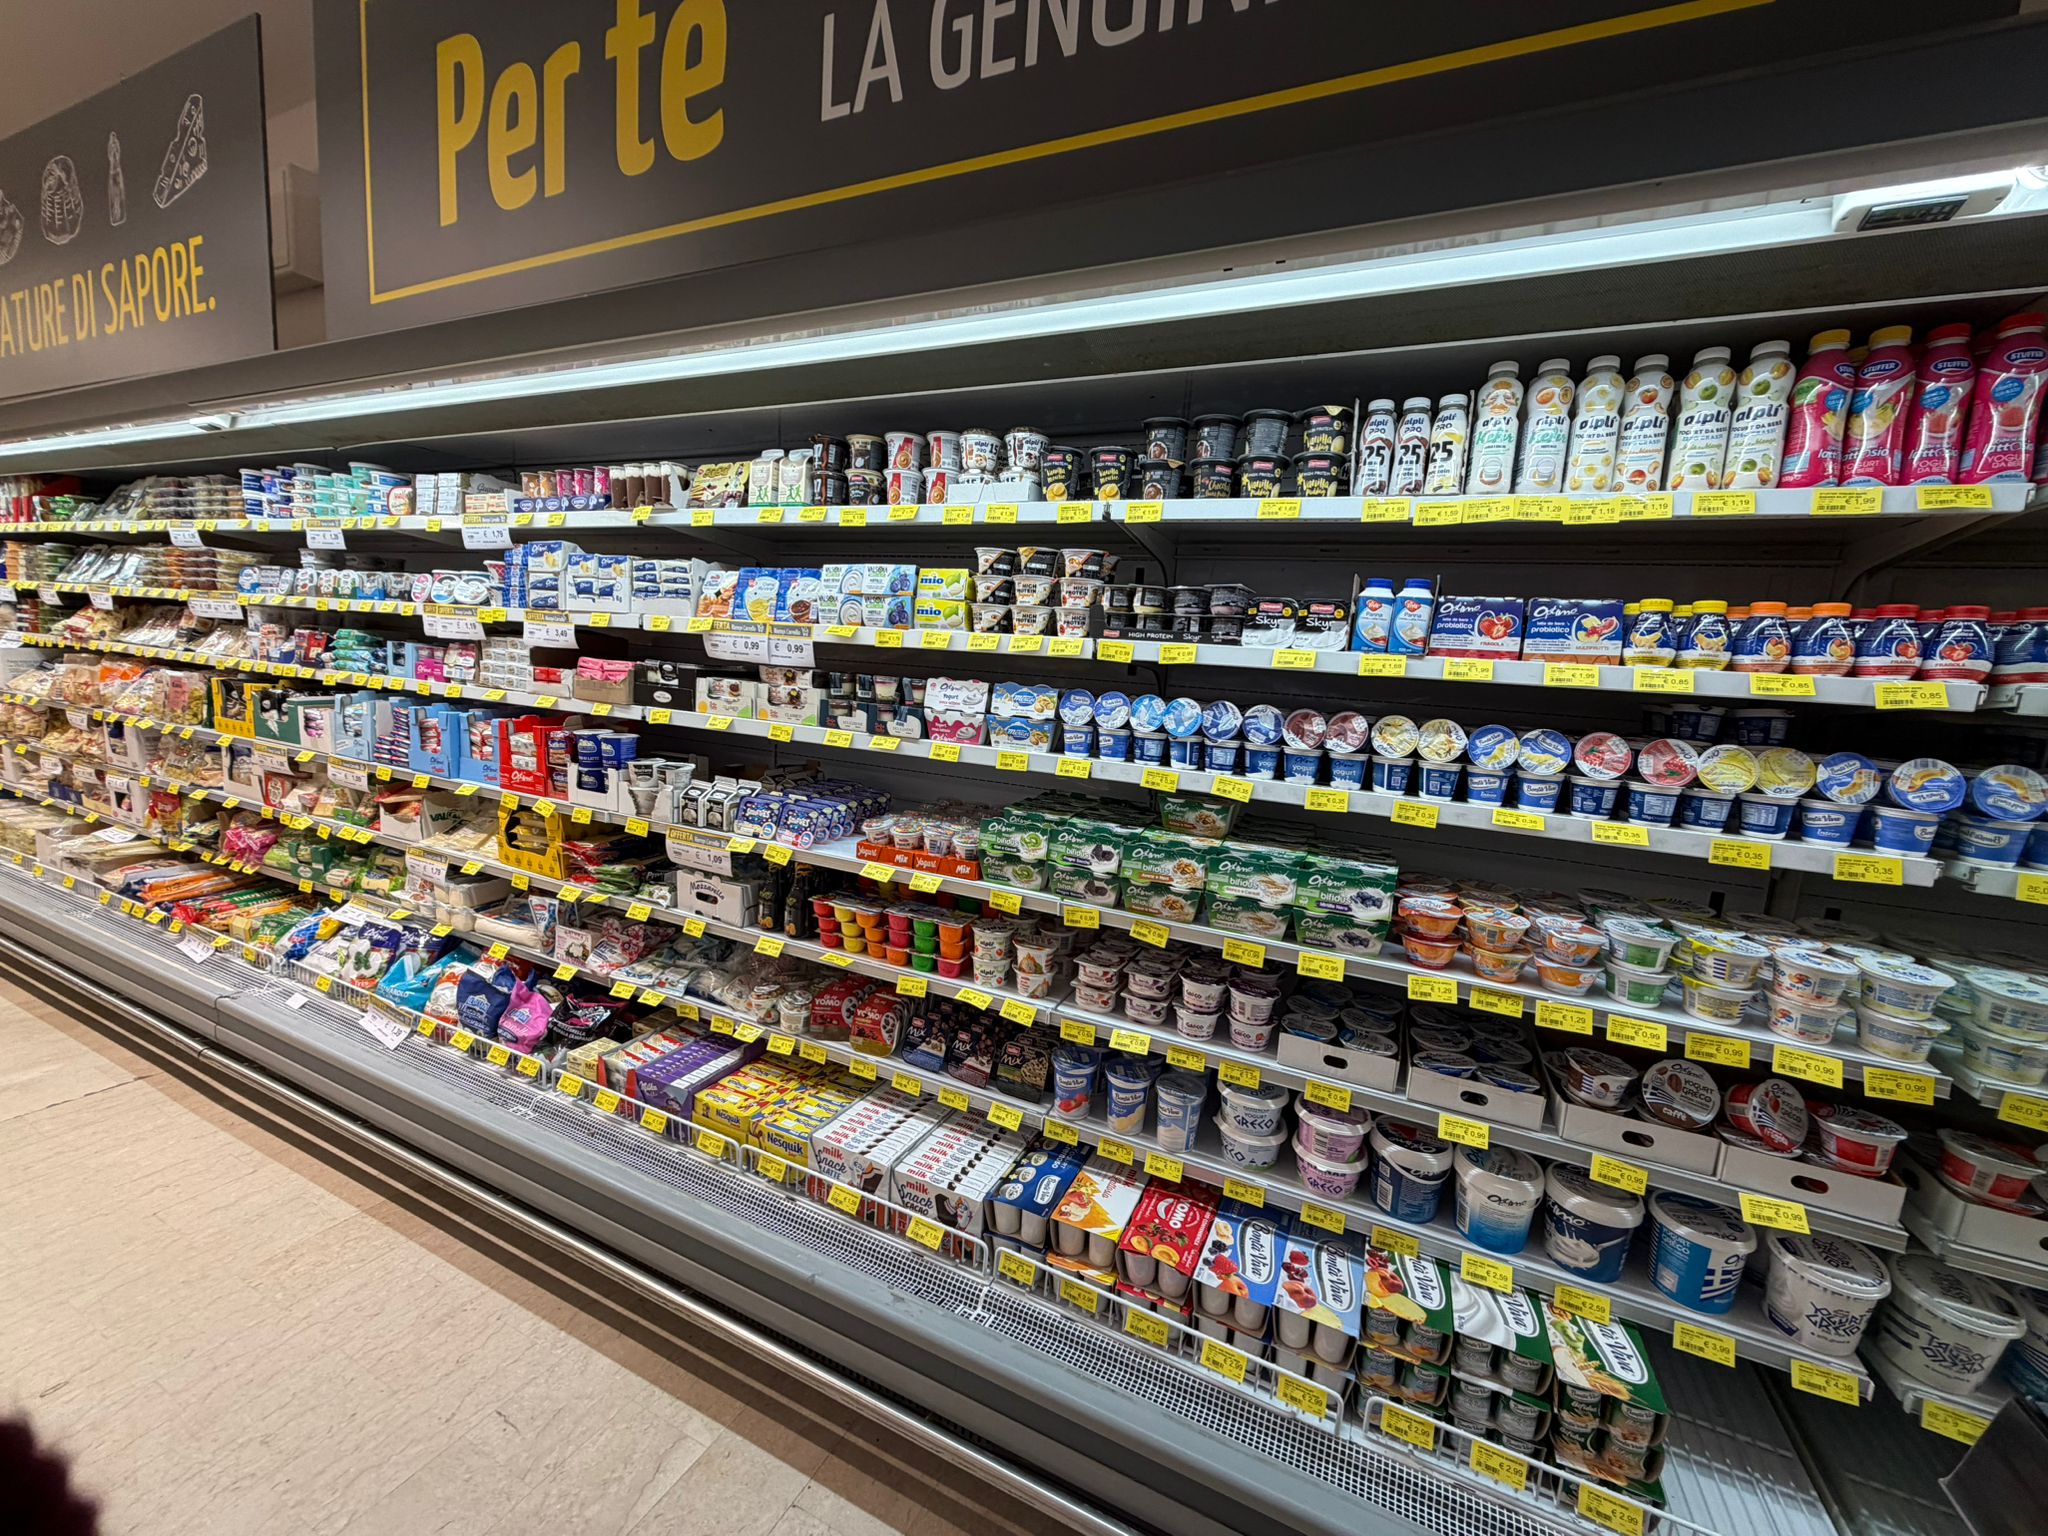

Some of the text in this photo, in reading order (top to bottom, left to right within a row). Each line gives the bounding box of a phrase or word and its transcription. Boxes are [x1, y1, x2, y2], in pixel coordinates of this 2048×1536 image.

[821, 0, 903, 122] LA
[435, 33, 581, 228] Per
[605, 0, 727, 177] te
[72, 270, 96, 340] DI
[101, 235, 216, 334] SAPORE.
[1863, 362, 1899, 373] STUFFER
[1364, 446, 1386, 465] 25
[1430, 441, 1454, 464] 25
[1854, 497, 1876, 505] 1,99
[920, 576, 944, 585] mio
[917, 607, 941, 616] mio
[1255, 616, 1282, 628] Skyr
[1306, 617, 1335, 630] Skyr
[1437, 622, 1473, 630] probiotico
[1182, 633, 1202, 642] Skyr
[744, 641, 760, 650] 0,99
[787, 644, 804, 654] 0,99
[1333, 769, 1356, 777] yogurt
[1422, 812, 1436, 820] 0,35
[707, 853, 722, 864] 1,09
[895, 854, 908, 863] Mix
[1744, 852, 1763, 860] 0,35
[956, 865, 971, 874] Mix
[1143, 864, 1171, 874] bifidus
[1873, 866, 1893, 874] 0,35
[815, 999, 840, 1008] YOMO
[1570, 1016, 1586, 1024] 1,29
[1641, 1030, 1660, 1040] 0,99
[1715, 1046, 1743, 1058] € 0,99
[1805, 1062, 1835, 1076] € 0,99
[1684, 1078, 1715, 1095] YOGURT
[1895, 1082, 1926, 1094] € 0,99
[1682, 1087, 1713, 1103] GRECO
[716, 1107, 741, 1123] Nesquik
[855, 1111, 873, 1120] milk
[1662, 1107, 1688, 1122] caffè
[1234, 1115, 1274, 1130] GRECO
[840, 1124, 857, 1134] milk
[824, 1133, 843, 1144] milk
[943, 1132, 961, 1142] milk
[1463, 1130, 1486, 1141] € 0,99
[767, 1132, 803, 1154] Nesquik
[822, 1145, 844, 1160] milk
[928, 1146, 948, 1157] milk
[816, 1149, 847, 1174] Snack
[907, 1167, 928, 1179] milk
[1620, 1171, 1644, 1185] € 0,99
[906, 1180, 929, 1195] milk
[1307, 1176, 1343, 1194] GRECO
[898, 1184, 934, 1209] Snack
[905, 1201, 929, 1216] CACAO
[1775, 1211, 1803, 1223] € 0,99
[1492, 1271, 1508, 1281] 2,59
[1581, 1301, 1606, 1313] € 2,59
[1704, 1341, 1731, 1354] € 3,99
[1611, 1342, 1635, 1378] Viva
[1824, 1379, 1854, 1394] € 4,39
[1407, 1422, 1430, 1437] € 2,99
[1499, 1460, 1524, 1478] € 2,99
[1611, 1508, 1639, 1526] € 2,99
